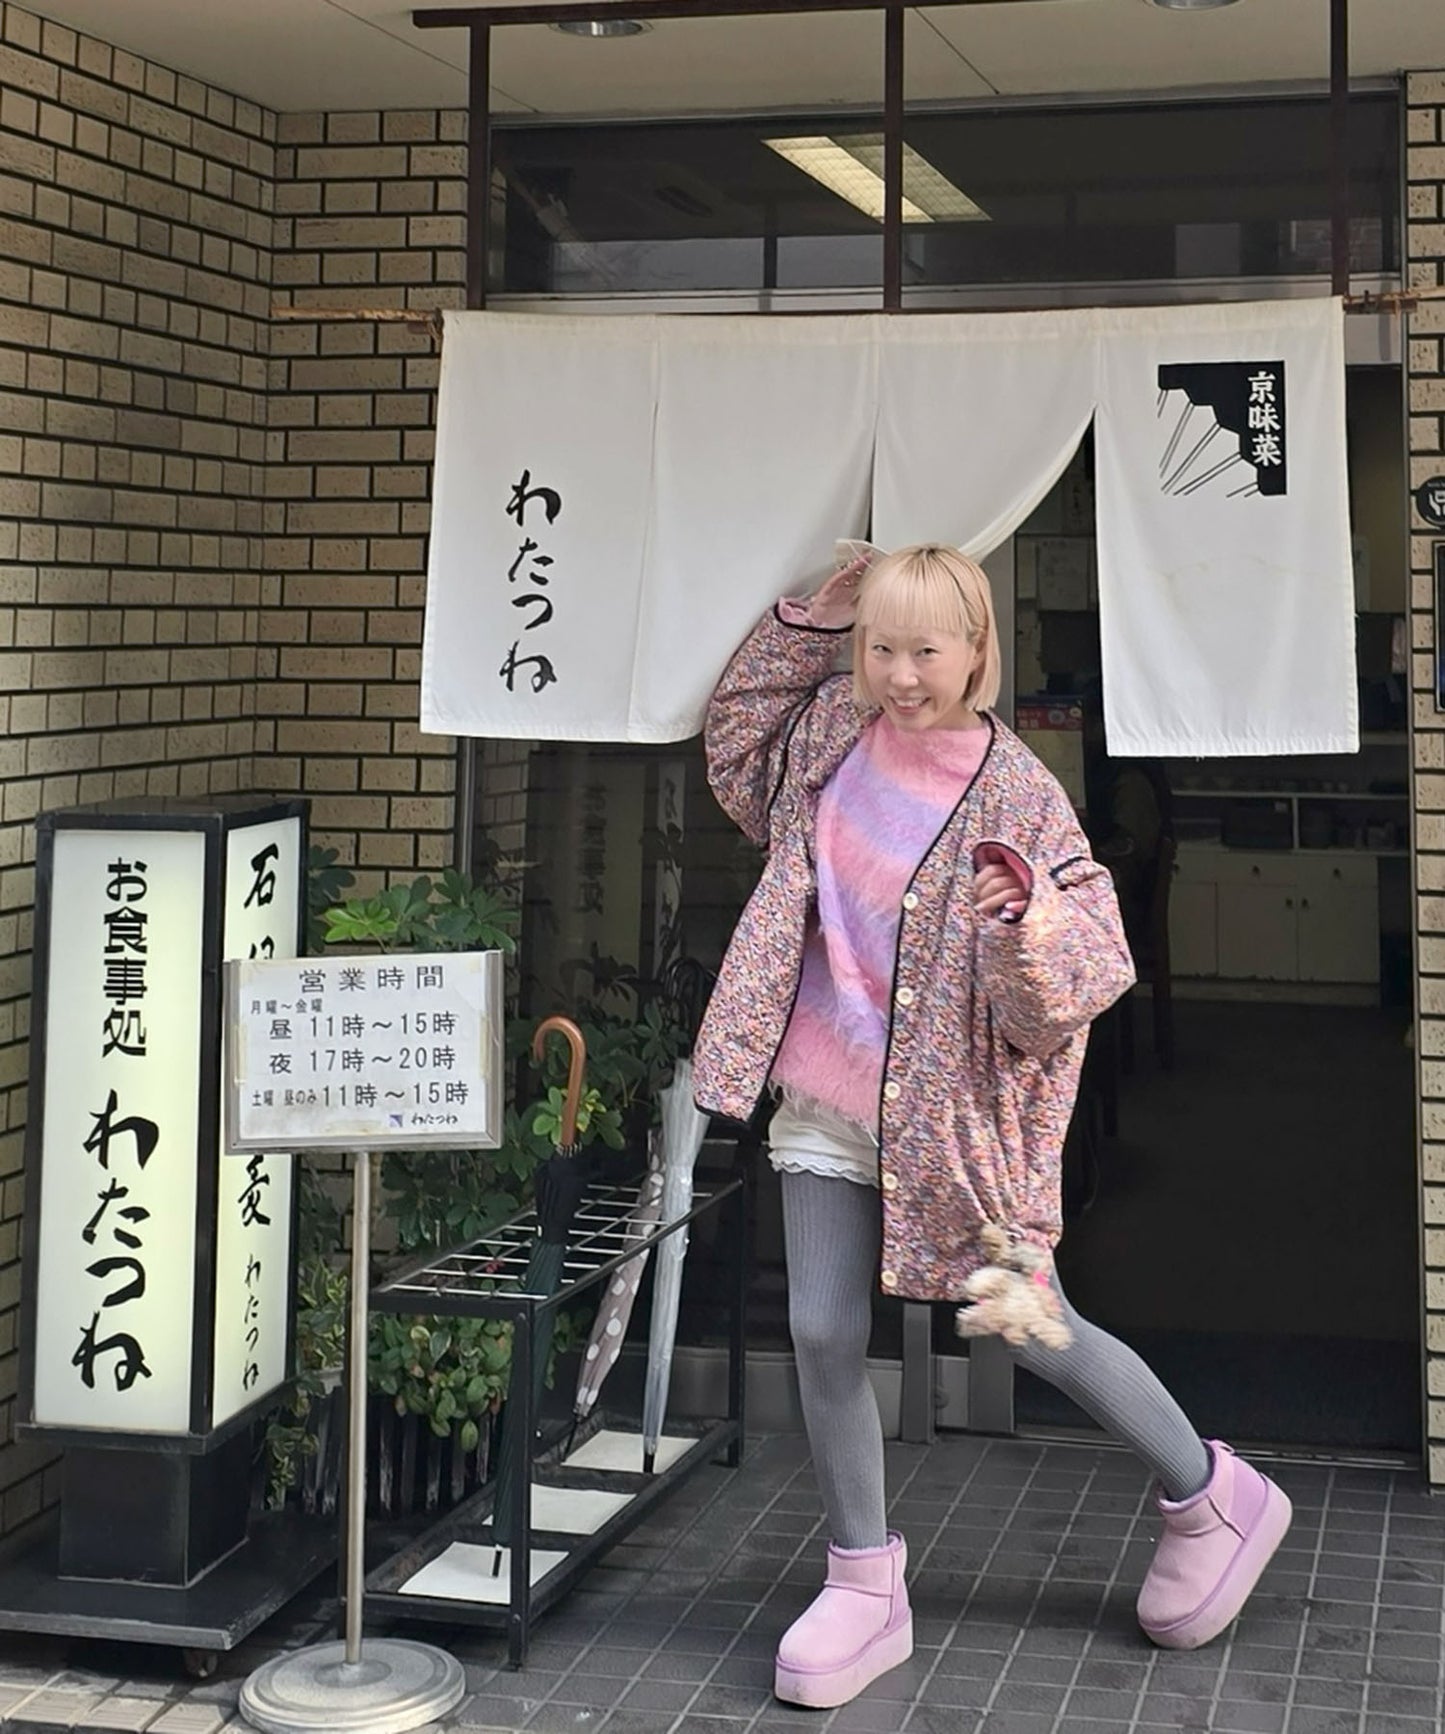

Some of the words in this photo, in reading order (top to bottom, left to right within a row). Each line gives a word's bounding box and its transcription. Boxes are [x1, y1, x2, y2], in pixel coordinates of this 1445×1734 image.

[1248, 370, 1282, 467] 京味菜
[499, 468, 563, 693] わたつね
[103, 857, 148, 1058] お食事処
[299, 965, 444, 994] 営業時間
[269, 1018, 292, 1040] 昼
[310, 1010, 456, 1039] 11時～15時
[269, 1053, 292, 1075] 夜
[310, 1045, 456, 1073] 17時～20時
[72, 1088, 160, 1392] わたつね
